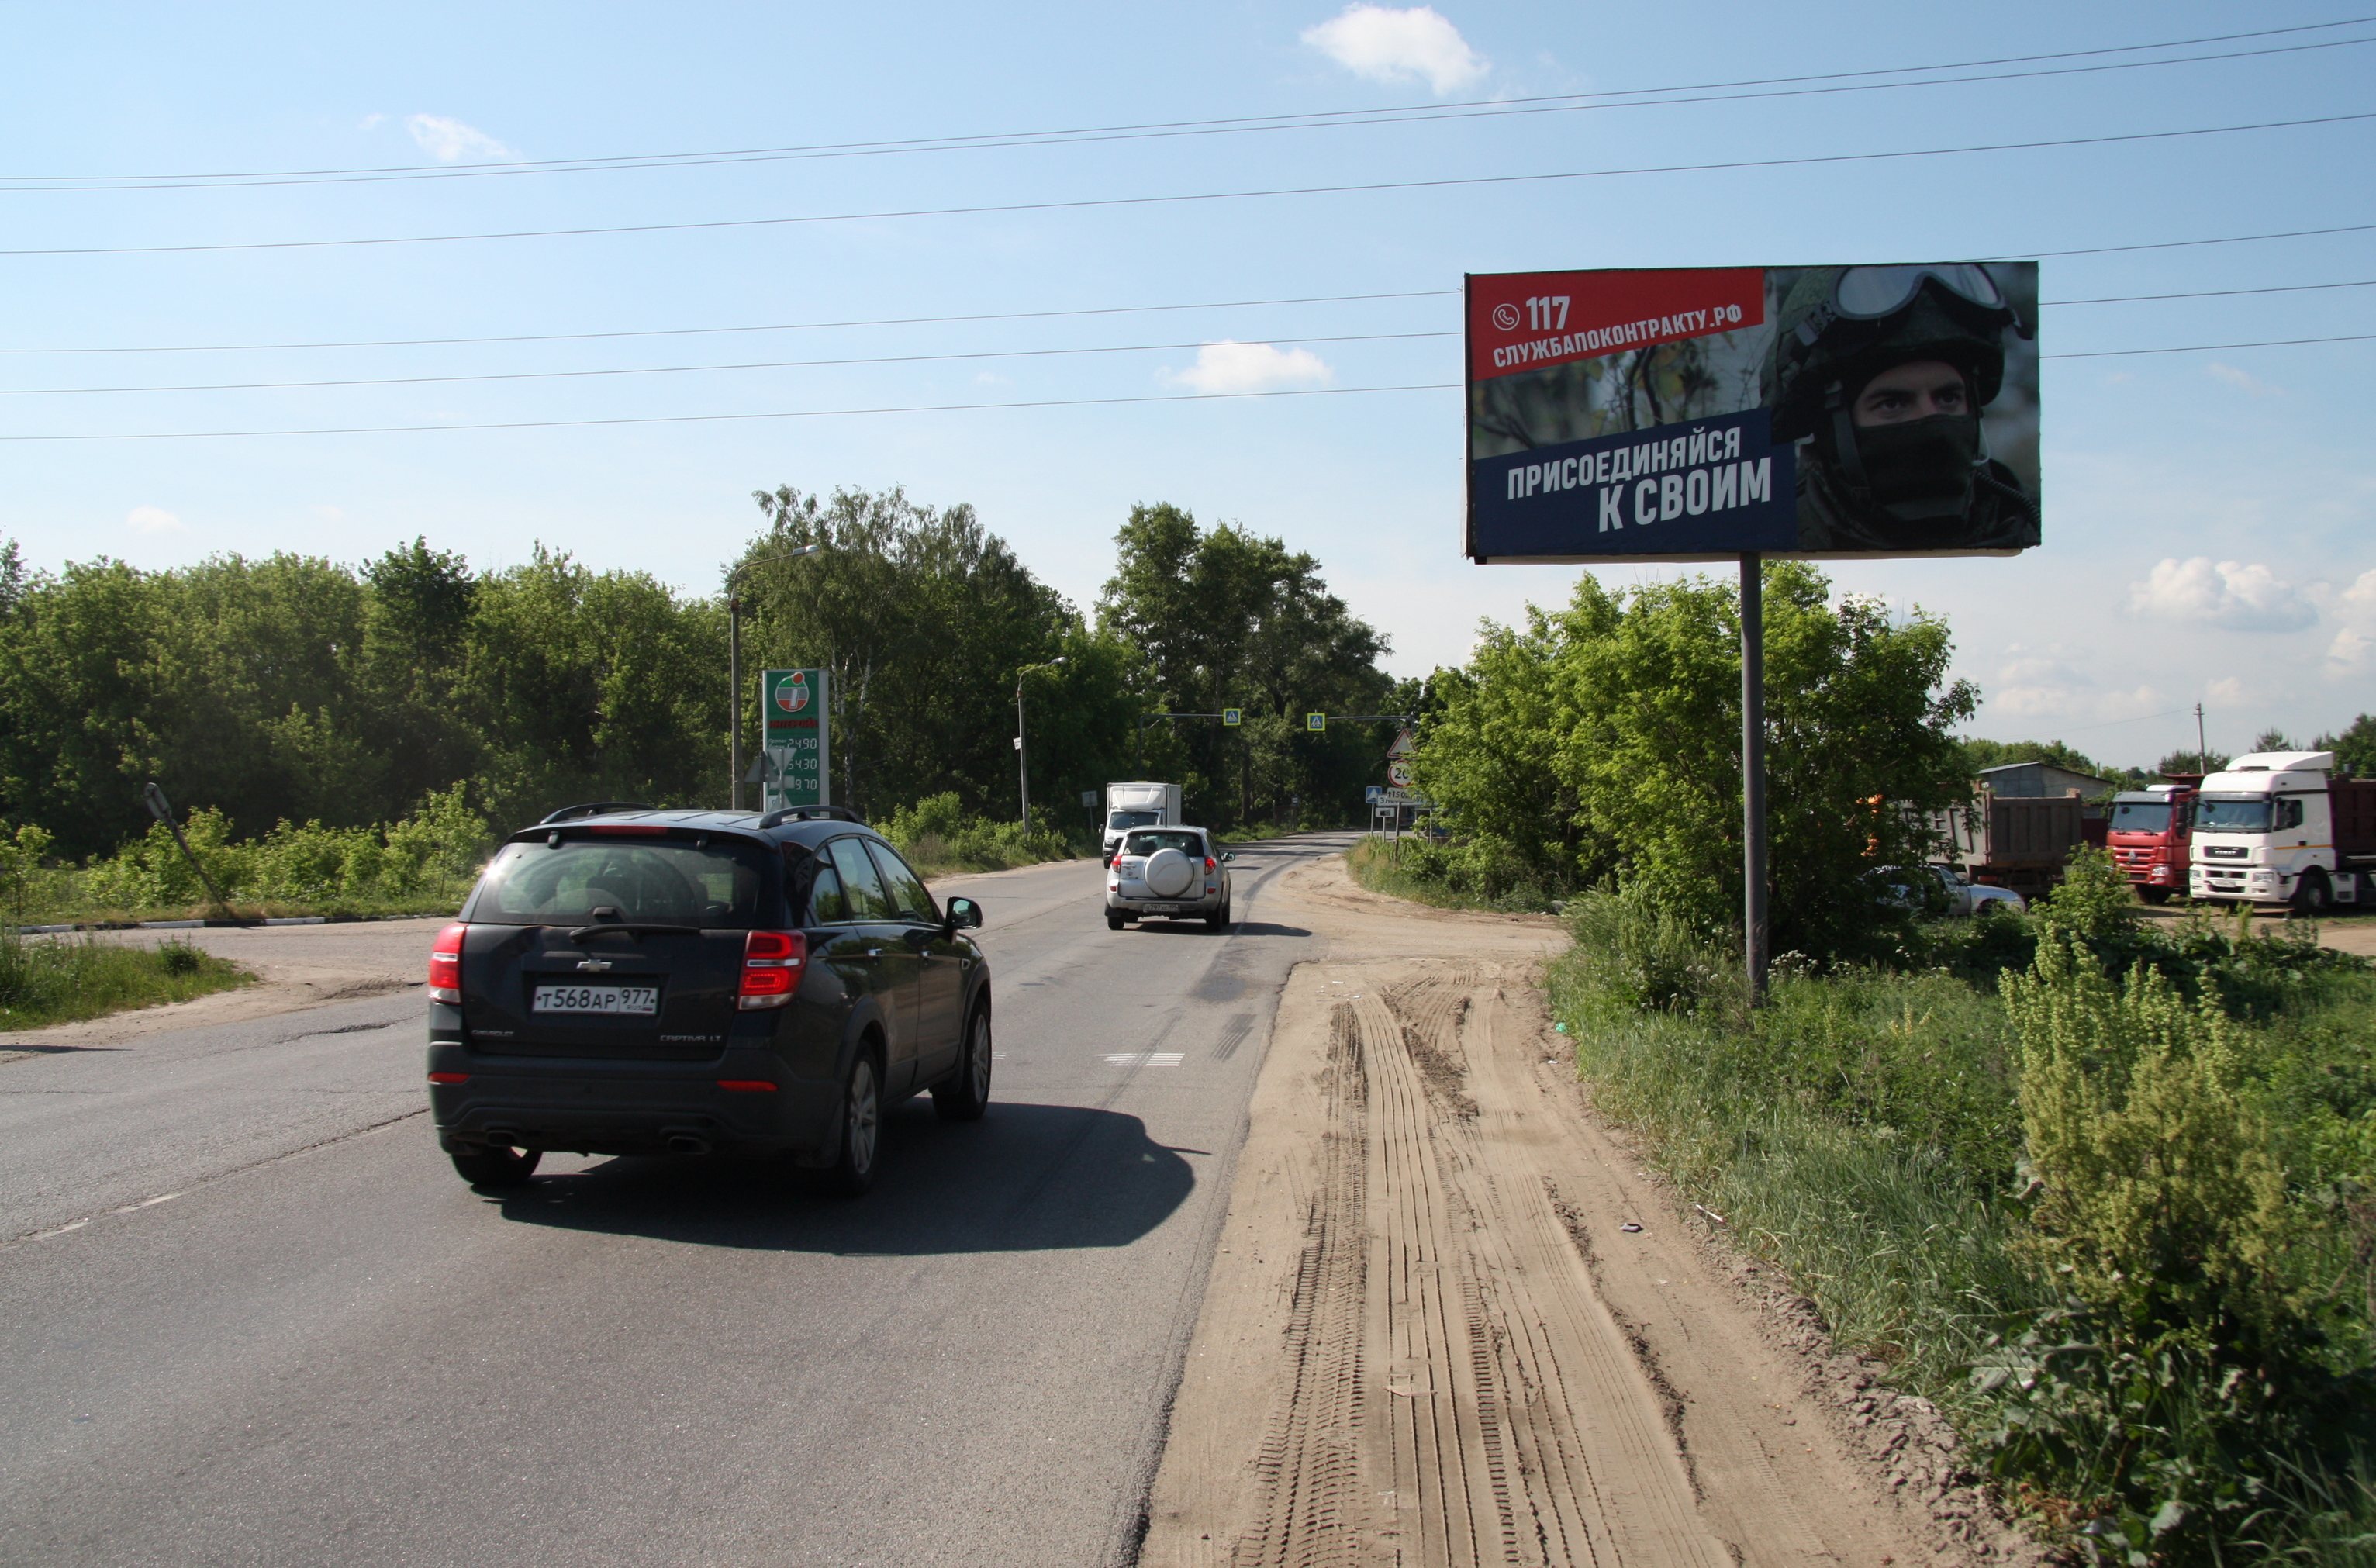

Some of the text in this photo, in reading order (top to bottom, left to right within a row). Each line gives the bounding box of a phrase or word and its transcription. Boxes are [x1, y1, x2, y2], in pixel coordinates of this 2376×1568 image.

[1493, 303, 1742, 368] СЛУЖБАПОКОНТРАКТУ.РФ
[1525, 295, 1570, 330] 117
[1507, 426, 1741, 500] ПРИСОЕДИНЯЙСЯ
[1599, 456, 1772, 533] К СВОИМ
[621, 989, 652, 1004] 977
